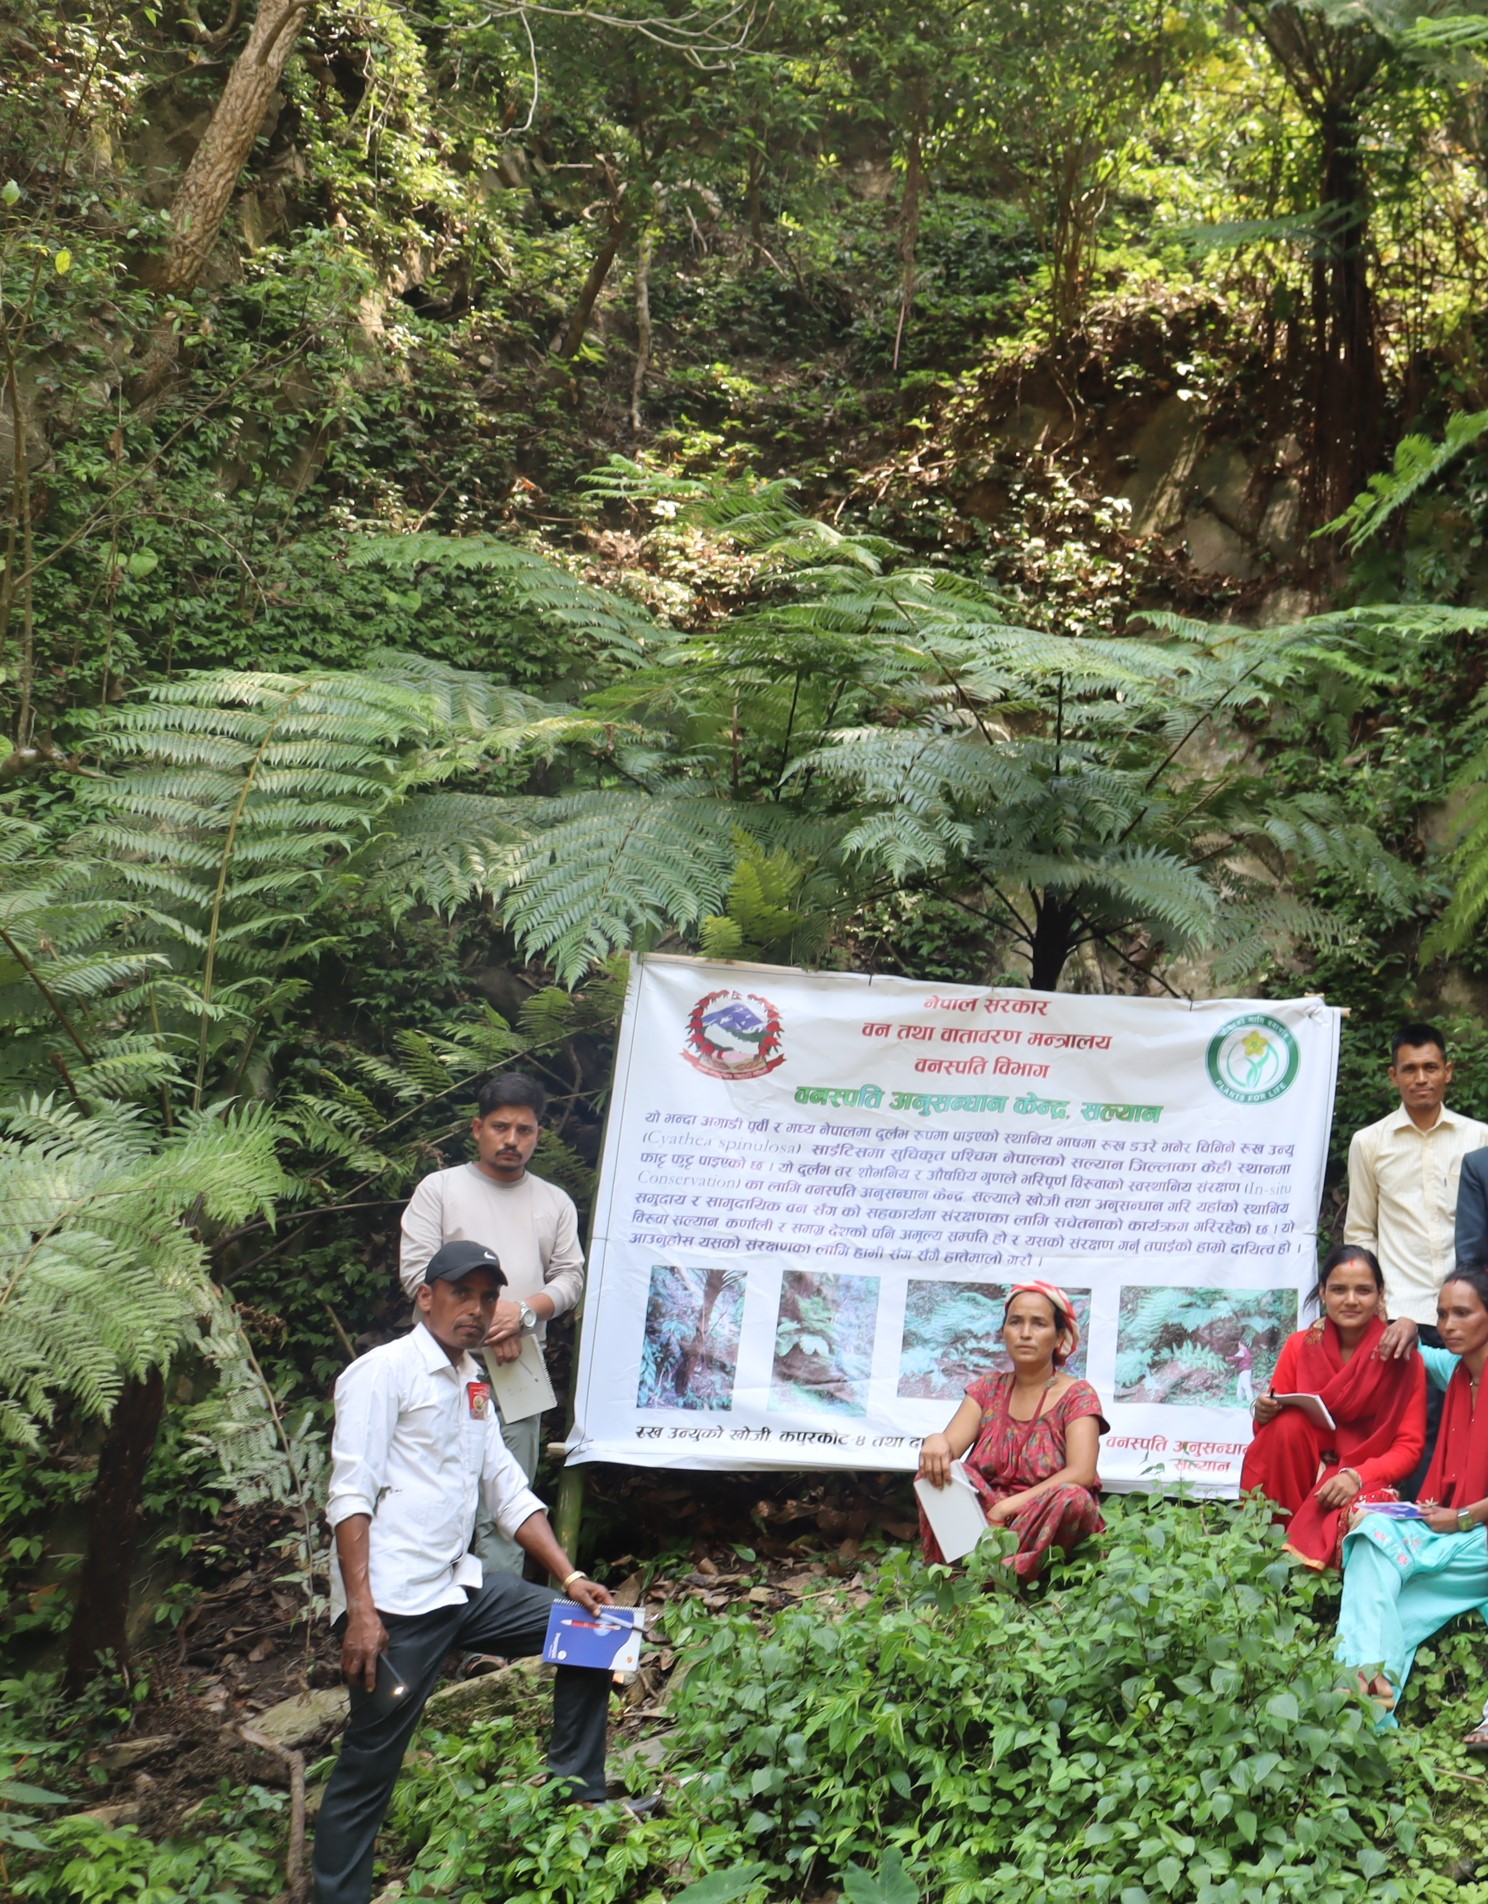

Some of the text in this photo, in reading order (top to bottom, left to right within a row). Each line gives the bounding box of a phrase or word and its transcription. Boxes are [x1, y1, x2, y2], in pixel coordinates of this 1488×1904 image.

[924, 996, 1051, 1016] नेपाल सरकार
[862, 1022, 1112, 1050] वन तथा वातावरण मन्त्रालय
[914, 1055, 1050, 1079] वनस्पति विभाग
[794, 1084, 885, 1109] वनस्पति
[889, 1091, 1010, 1117] अनुसन्धान
[1080, 1102, 1164, 1123] सल्यान
[1216, 1079, 1287, 1102] PLANTS FOR LIFE
[645, 1110, 660, 1124] यो
[664, 1113, 696, 1126] भन्दा
[700, 1115, 743, 1130] अगाडी
[773, 1123, 782, 1133] र
[786, 1122, 815, 1135] मध्य
[819, 1122, 871, 1138] नेपालमा
[876, 1126, 909, 1142] दुर्लभ
[953, 1129, 999, 1143] पाइएको
[1004, 1131, 1053, 1146] स्थानिय
[1161, 1140, 1192, 1153] भनेर
[1196, 1140, 1236, 1153] चिनिने
[643, 1130, 712, 1147] (Cyathea
[718, 1137, 802, 1154] spinulosa)
[1003, 1150, 1065, 1167] नेपालको
[1071, 1158, 1124, 1170] सल्यान
[1128, 1158, 1197, 1173] जिल्लाका
[1201, 1159, 1233, 1174] केही
[1237, 1163, 1291, 1175] स्थानमा
[699, 1156, 746, 1170] पाइएको
[751, 1160, 764, 1171] छ
[778, 1160, 793, 1173] यो
[797, 1162, 831, 1178] दुर्लभ
[835, 1166, 852, 1178] तर
[914, 1170, 922, 1180] र
[981, 1170, 1017, 1185] गुणले
[1021, 1173, 1067, 1190] भरिपूर्ण
[1128, 1178, 1192, 1193] स्वस्थानिय
[1197, 1180, 1242, 1193] संरक्षण
[638, 1171, 740, 1189] Conservation)
[745, 1179, 764, 1191] का
[768, 1179, 801, 1194] लागि
[805, 1182, 856, 1197] वनस्पति
[861, 1186, 928, 1202] अनुसन्धान
[972, 1190, 1021, 1205] सल्याले
[1025, 1192, 1060, 1207] खोजी
[1065, 1197, 1091, 1209] तथा
[1095, 1198, 1163, 1214] अनुसन्धान
[1167, 1198, 1190, 1213] गरि
[1243, 1201, 1289, 1215] स्थानिय
[635, 1191, 685, 1207] समुदाय
[690, 1196, 700, 1206] र
[786, 1203, 807, 1214] वन
[841, 1203, 861, 1218] को
[866, 1206, 936, 1221] सहकार्यमा
[941, 1208, 1009, 1224] संरक्षणका
[1013, 1212, 1049, 1227] लागि
[1054, 1215, 1123, 1231] सचेतनाको
[1128, 1218, 1189, 1233] कार्यक्रम
[1193, 1218, 1251, 1235] गरिरहेको
[1255, 1224, 1268, 1235] छ
[1281, 1219, 1296, 1233] यो
[698, 1235, 741, 1250] यसको
[745, 1237, 811, 1254] संरक्षणका
[816, 1243, 850, 1257] लागि
[853, 1246, 883, 1259] हामी
[944, 1249, 1001, 1265] हातेमालो
[725, 1215, 773, 1231] कर्णाली
[778, 1223, 787, 1233] र
[828, 1223, 867, 1239] देशको
[872, 1225, 896, 1239] पनि
[992, 1230, 1007, 1246] हो
[1012, 1236, 1021, 1246] र
[1024, 1234, 1064, 1248] यसको
[1069, 1236, 1115, 1250] संरक्षण
[1196, 1239, 1226, 1254] हाम्रो
[1230, 1241, 1275, 1255] दायित्व
[1277, 1240, 1291, 1255] हो
[872, 1436, 905, 1448] तथा
[1106, 1434, 1169, 1451] वनस्पति
